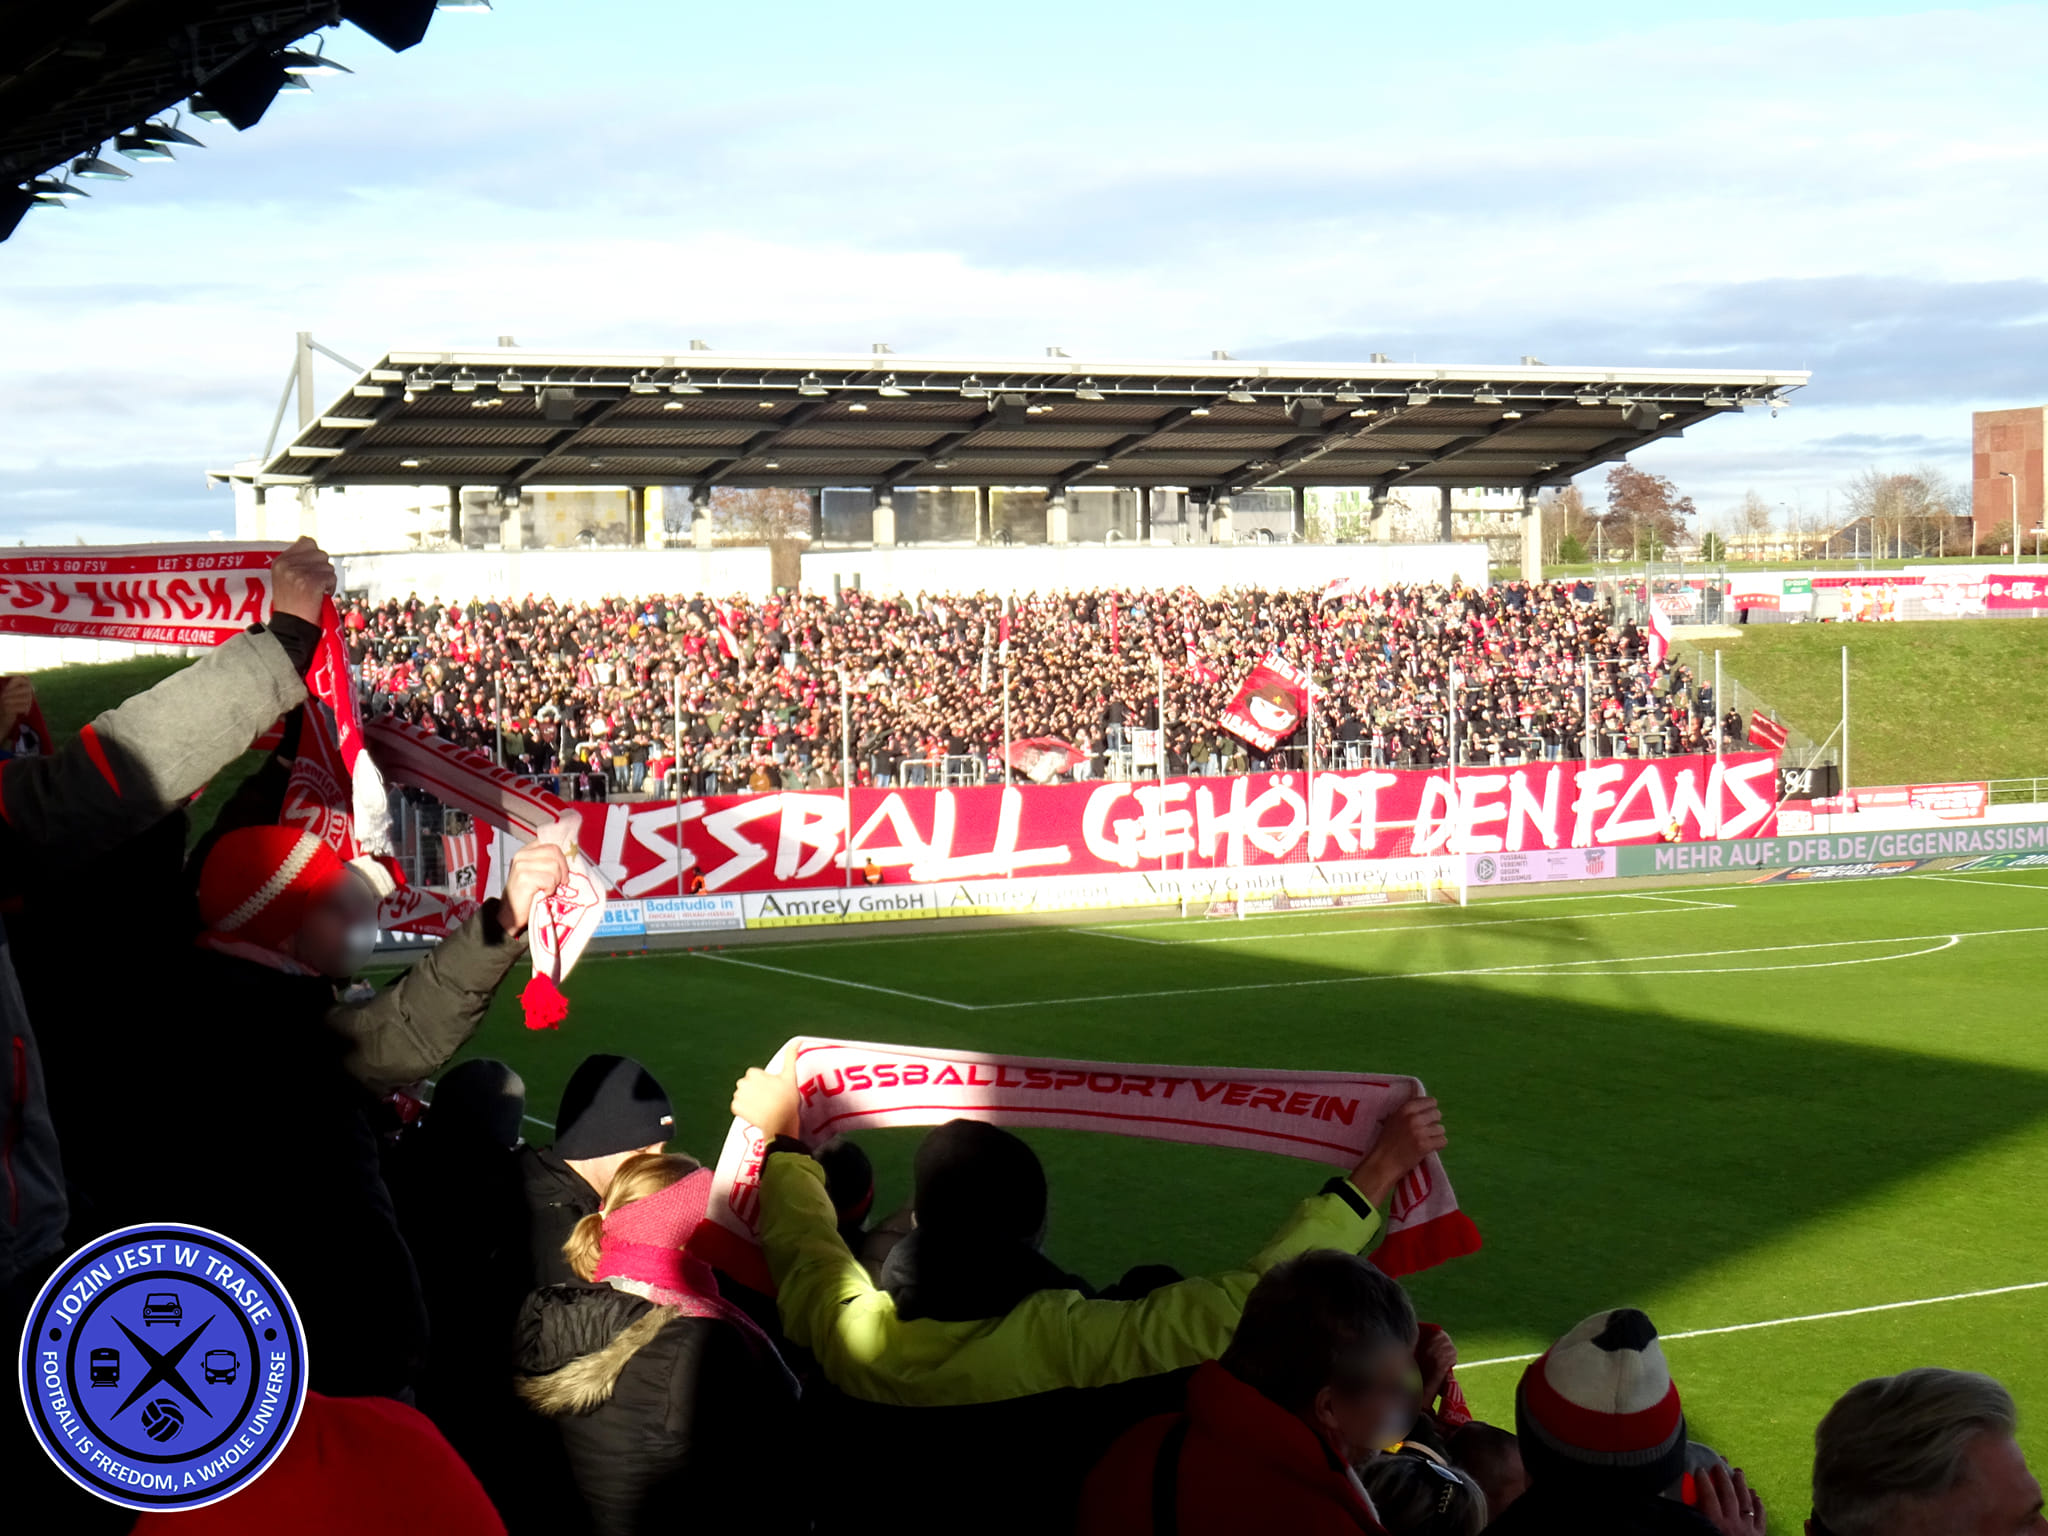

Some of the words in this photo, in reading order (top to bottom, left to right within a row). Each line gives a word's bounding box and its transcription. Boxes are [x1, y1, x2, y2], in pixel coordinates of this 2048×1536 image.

[64, 560, 80, 572] GO
[84, 560, 108, 572] FSV
[196, 556, 215, 569] GO
[218, 555, 244, 568] FSV
[75, 577, 274, 623] ZWICKA
[100, 625, 140, 639] NEVER
[141, 626, 176, 641] WALK
[177, 629, 216, 644] ALONE
[1082, 771, 1397, 867] GEHÖRT
[1410, 765, 1560, 855] DEN
[1572, 758, 1774, 848] FANS
[1655, 843, 1727, 870] MEHR
[1731, 839, 1781, 866] AUF:
[1787, 825, 2048, 863] DFB.DE/GEGENRASSISM
[1134, 873, 1217, 895] Amey
[646, 897, 716, 912] Badstudio
[720, 897, 733, 909] in
[758, 894, 850, 918] Amrey
[859, 894, 924, 911] GmbH
[600, 909, 640, 923] BELT
[798, 1063, 1359, 1126] FUSSBALLSPORTVEREIN
